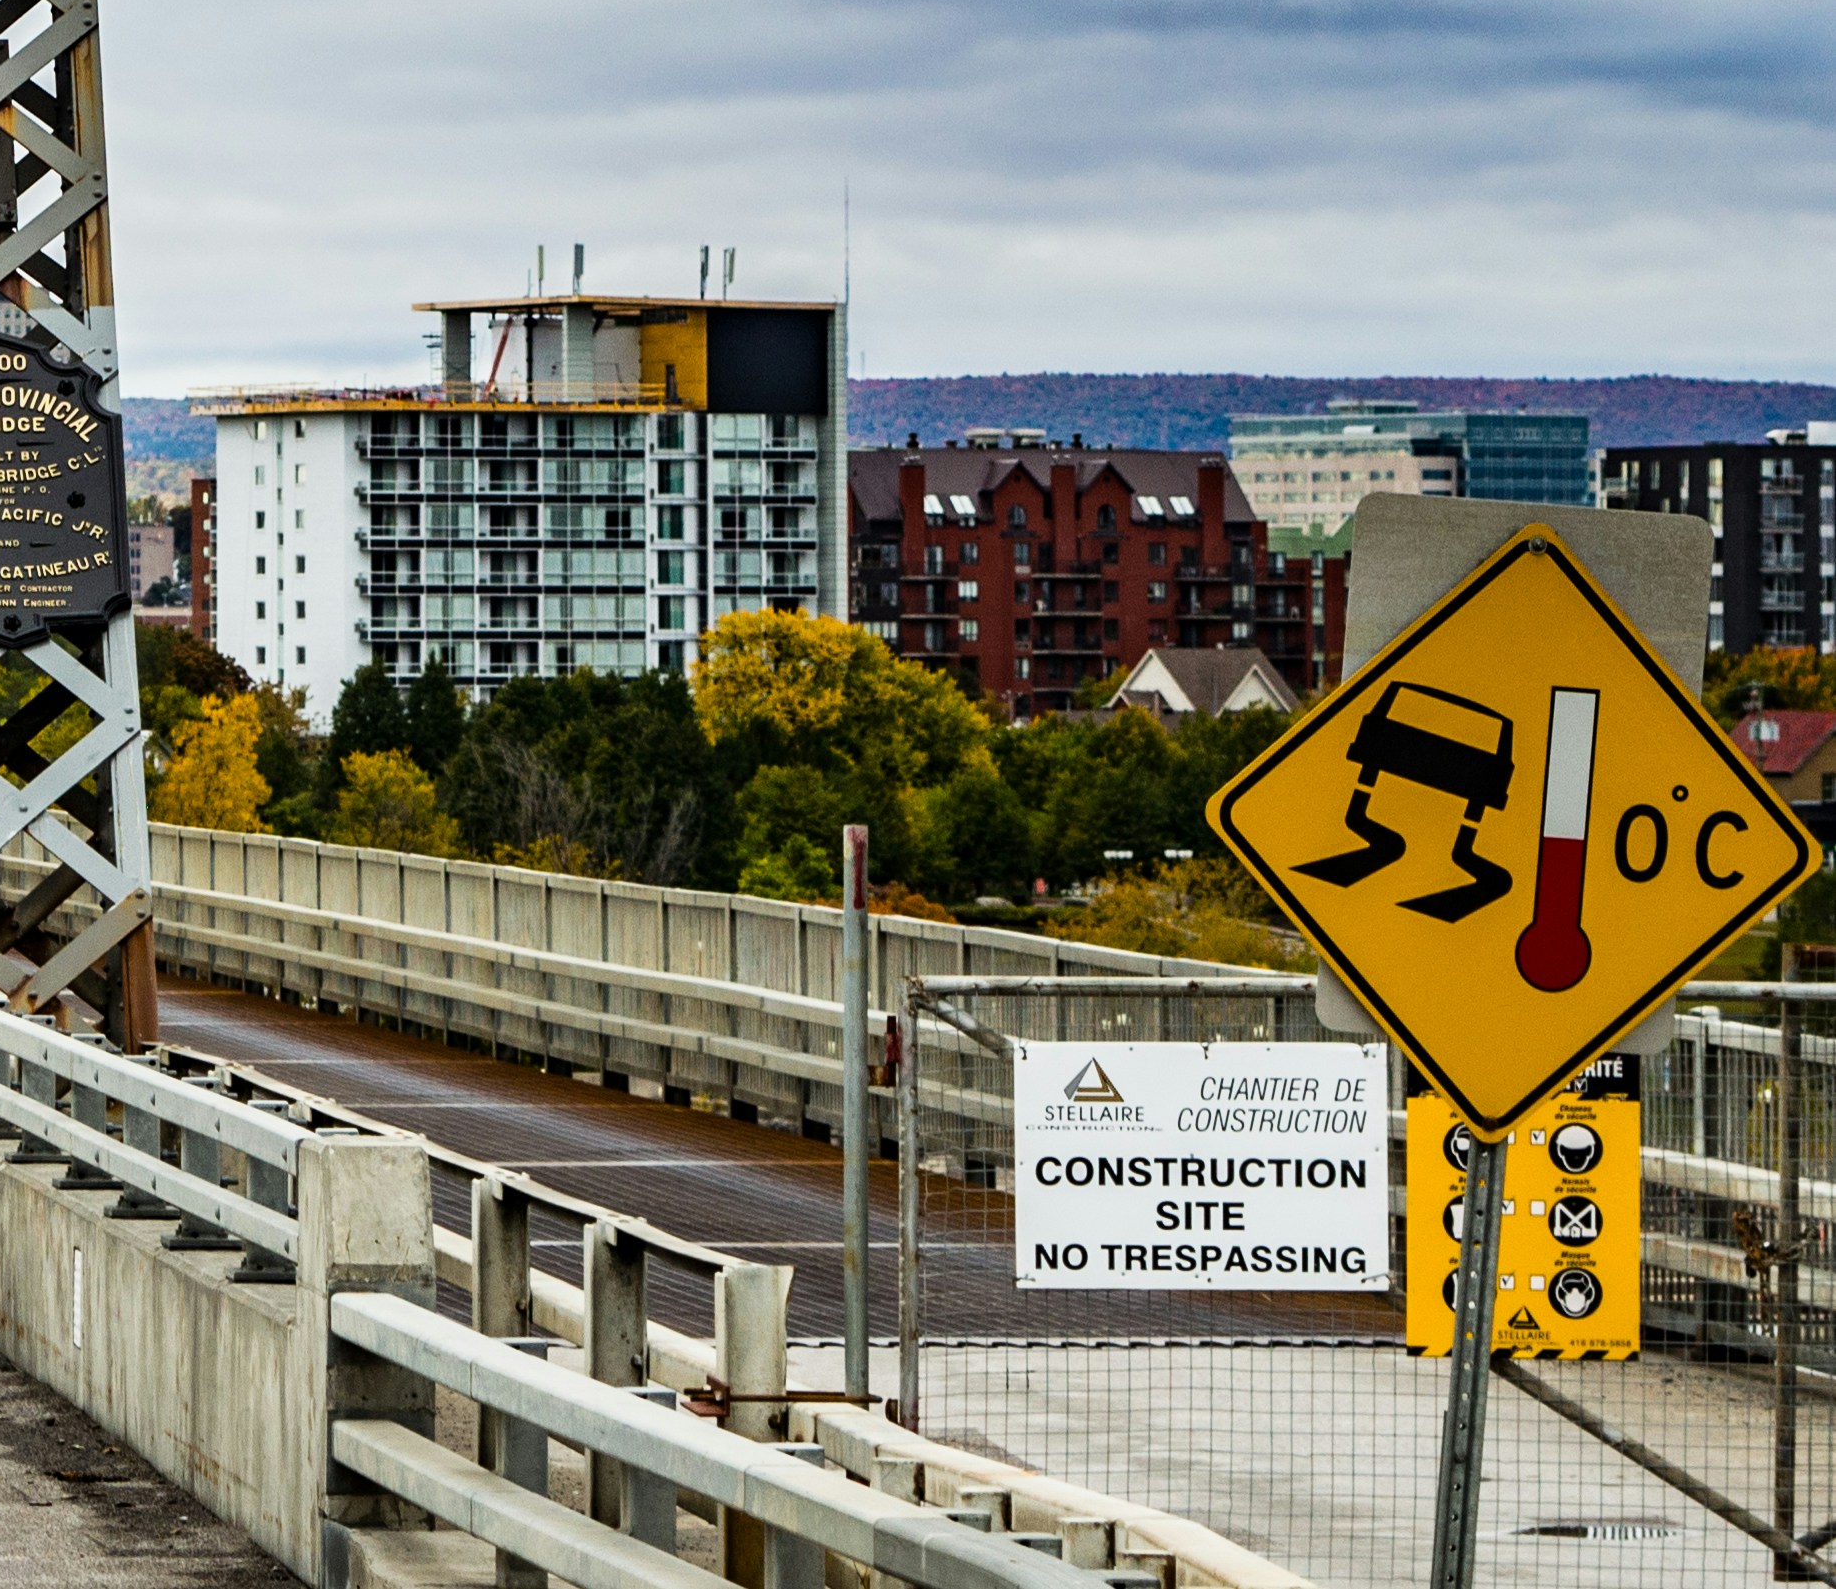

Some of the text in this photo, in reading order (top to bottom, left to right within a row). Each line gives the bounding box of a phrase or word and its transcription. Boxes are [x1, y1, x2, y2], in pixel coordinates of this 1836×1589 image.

[21, 451, 39, 461] BY
[1200, 1076, 1367, 1103] CHANTIER DE
[1045, 1105, 1144, 1122] STELLAIRE
[1177, 1108, 1367, 1134] CONSTRUCTION
[1035, 1156, 1367, 1188] CONSTRUCTION
[1156, 1201, 1245, 1231] SITE
[1034, 1244, 1367, 1274] NO TRESPASSING
[1498, 1330, 1550, 1340] STELLAIRE
